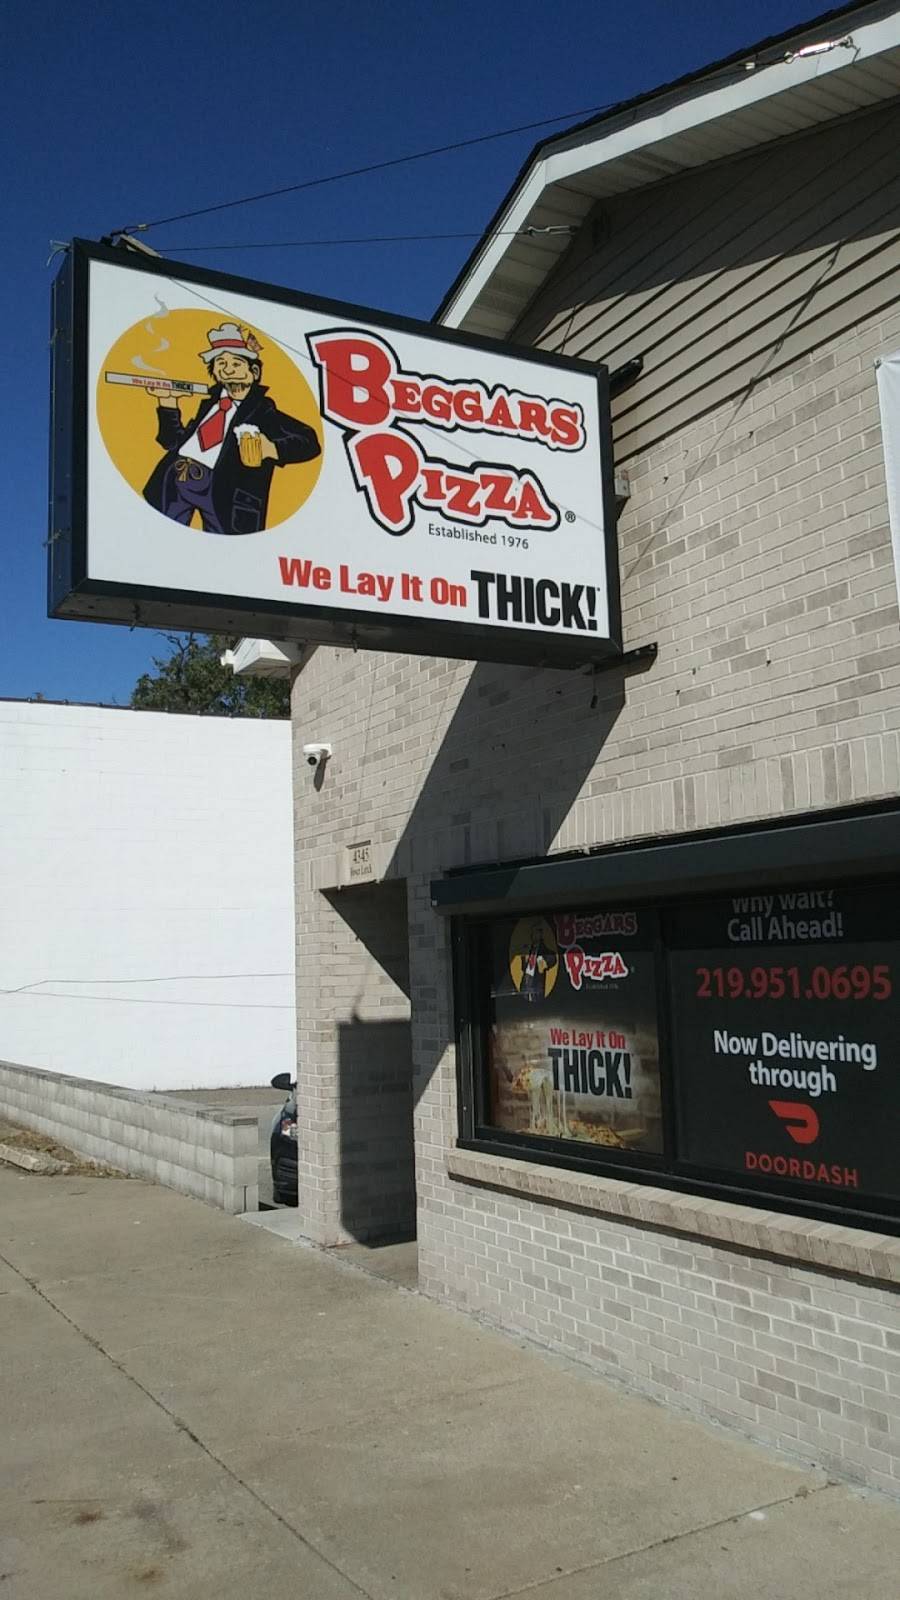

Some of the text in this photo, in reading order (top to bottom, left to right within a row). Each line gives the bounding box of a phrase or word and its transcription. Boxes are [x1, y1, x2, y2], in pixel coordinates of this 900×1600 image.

[312, 336, 583, 448] BEGGARS
[351, 431, 554, 528] PIZZA
[428, 523, 529, 550] Established 1976
[278, 556, 598, 631] We Lay It On THICK!
[732, 895, 774, 918] Why
[554, 911, 637, 946] BEGGARS
[727, 911, 844, 942] Call Ahead!
[565, 946, 627, 987] PIZZA
[696, 964, 892, 1000] 219.951.0695
[550, 1028, 625, 1050] We Lay It On
[714, 1030, 877, 1071] Now Delivering
[548, 1047, 632, 1099] THICK!
[749, 1060, 837, 1097] through
[745, 1151, 857, 1187] DOORDASH
